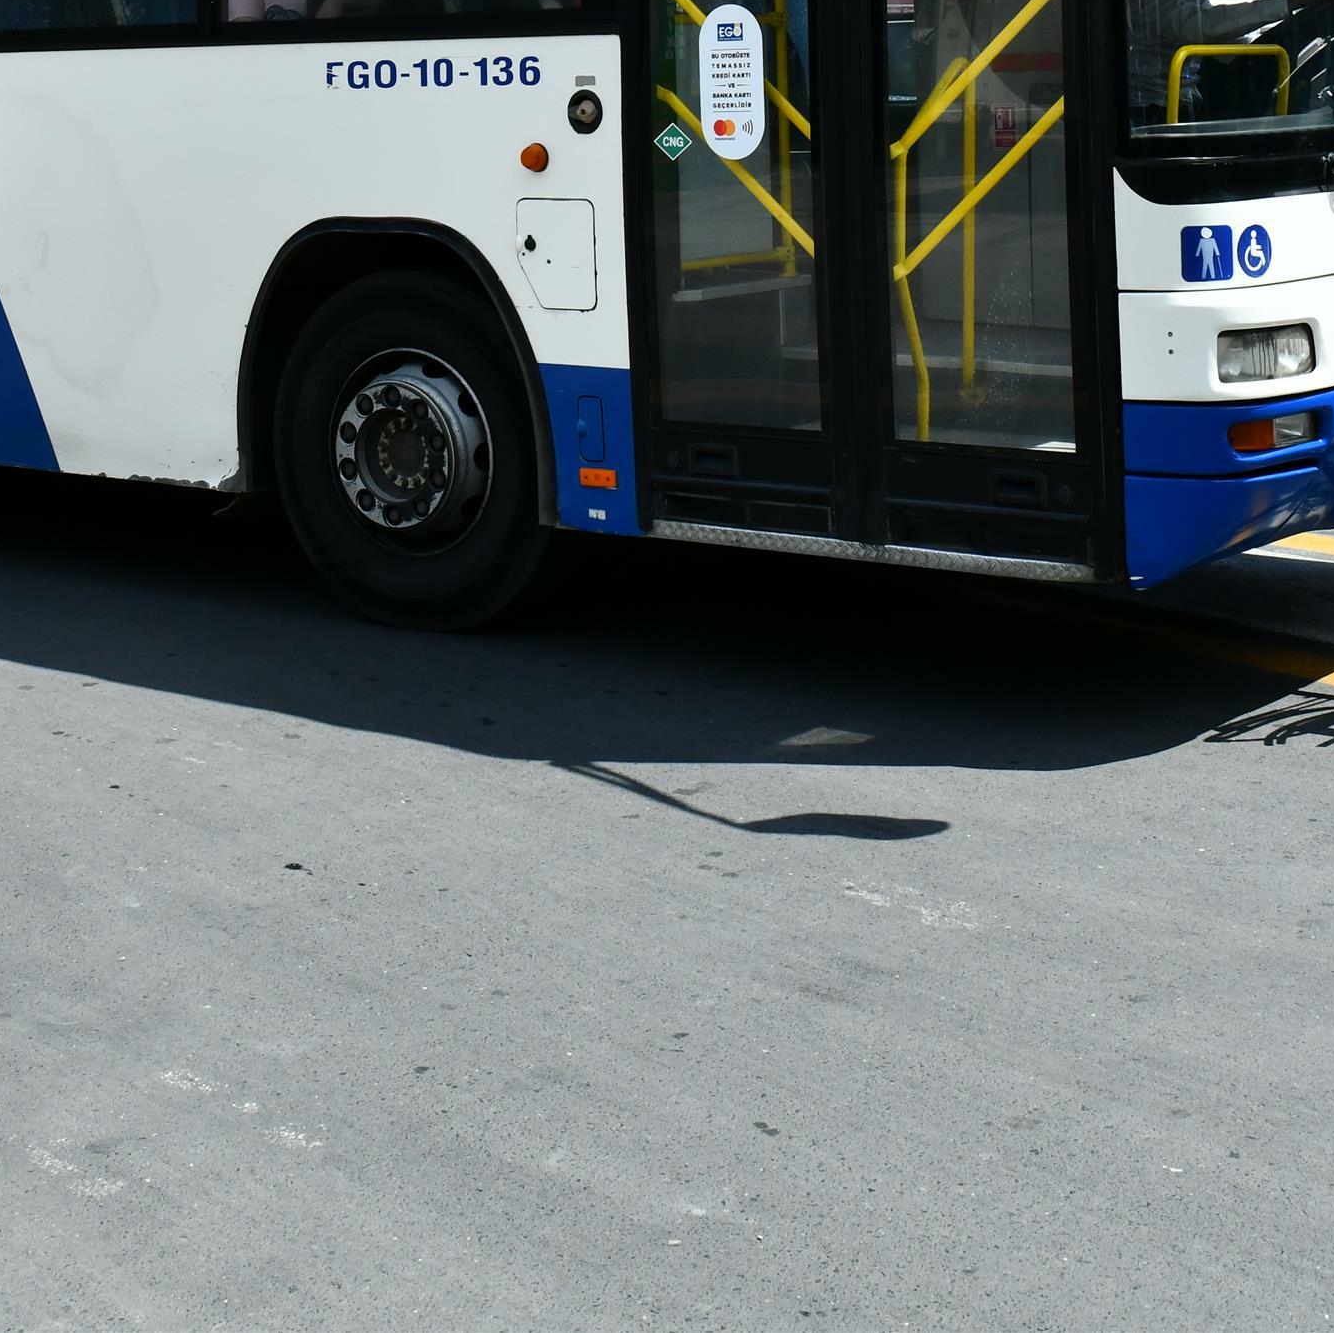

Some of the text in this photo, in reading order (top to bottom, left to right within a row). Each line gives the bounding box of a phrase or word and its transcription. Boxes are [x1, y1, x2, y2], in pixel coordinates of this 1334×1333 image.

[718, 25, 742, 38] EGO
[713, 101, 752, 109] GEÇERLİDİR
[662, 136, 684, 147] CNG
